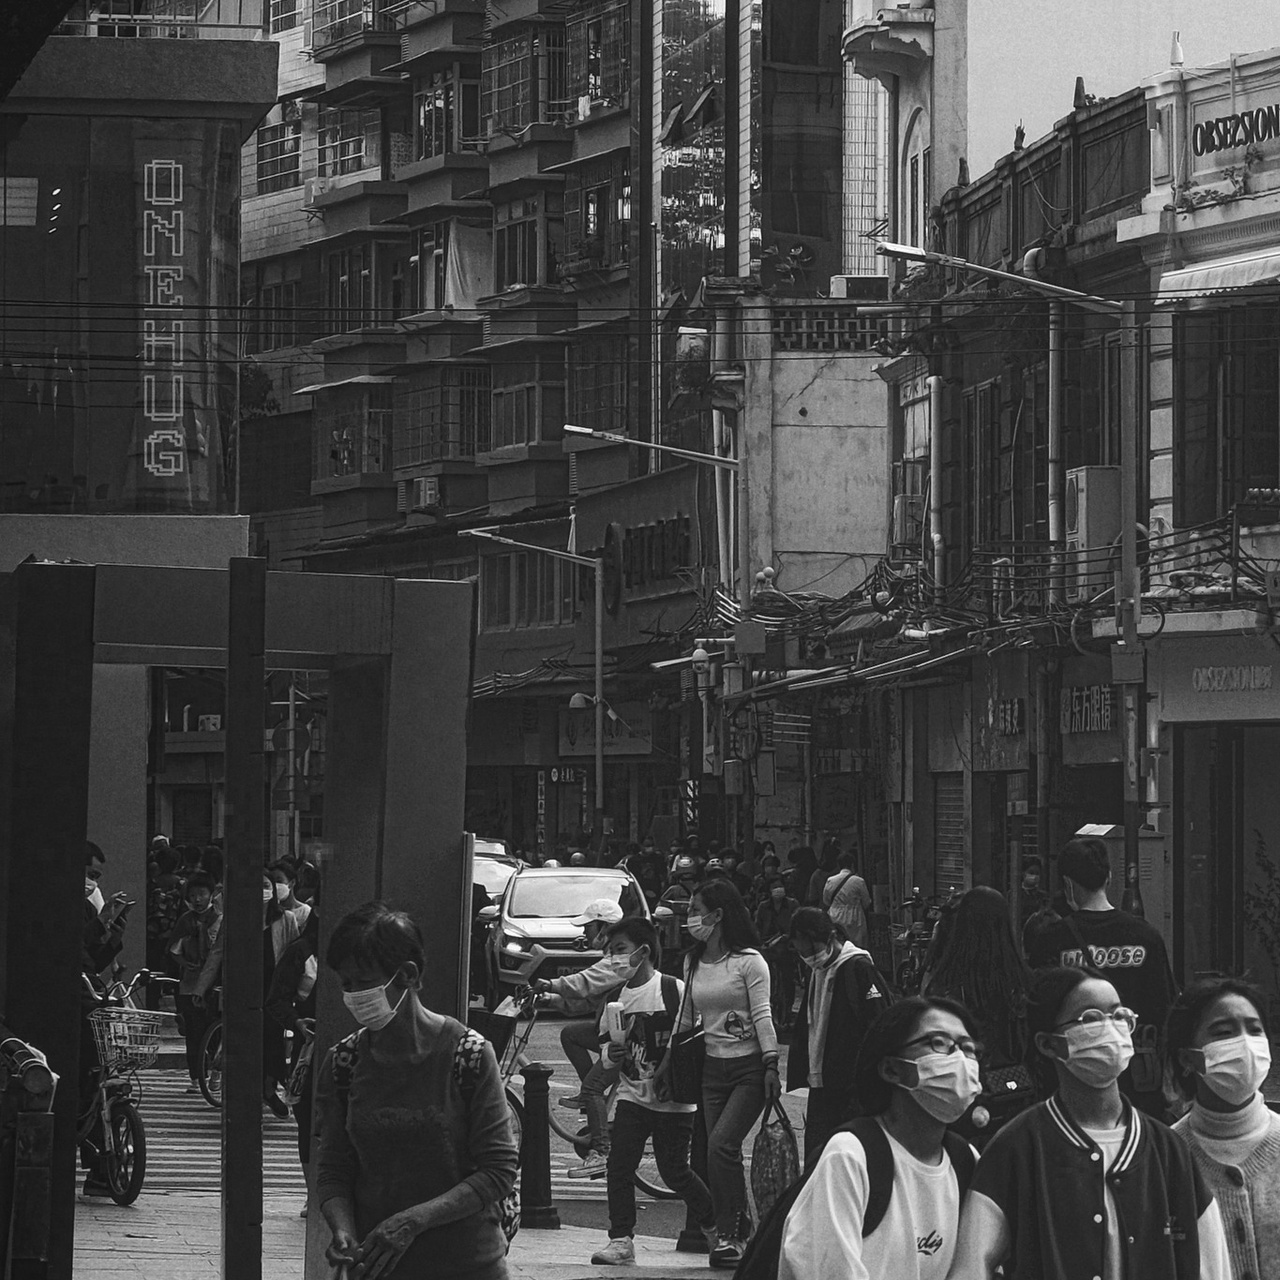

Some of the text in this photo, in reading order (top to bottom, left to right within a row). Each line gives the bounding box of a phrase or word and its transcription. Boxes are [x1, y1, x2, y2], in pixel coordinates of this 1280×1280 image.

[143, 159, 183, 476] ONEHUG
[1071, 685, 1111, 734] 东方眼镜
